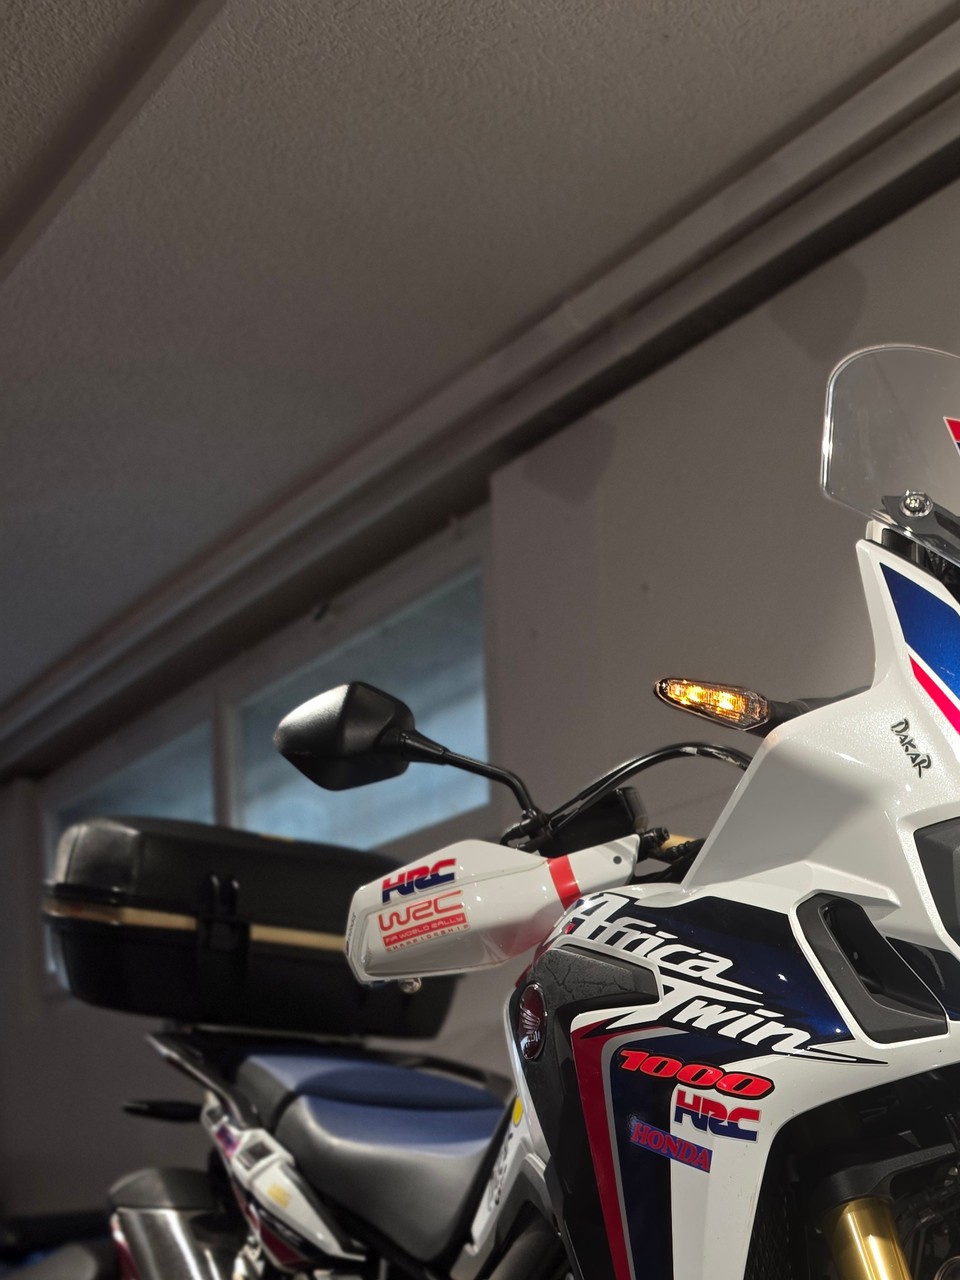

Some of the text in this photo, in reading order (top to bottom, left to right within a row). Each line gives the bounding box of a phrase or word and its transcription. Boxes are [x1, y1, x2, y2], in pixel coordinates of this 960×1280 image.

[890, 718, 932, 778] DAKAR
[382, 858, 456, 904] HRC
[378, 890, 464, 931] WRC
[399, 925, 430, 940] WORLD
[430, 916, 464, 929] RALLY
[570, 894, 763, 994] Africa
[606, 976, 857, 1061] Twin
[620, 1049, 774, 1097] 1000
[674, 1089, 762, 1142] HRC
[631, 1122, 713, 1172] HONDA
